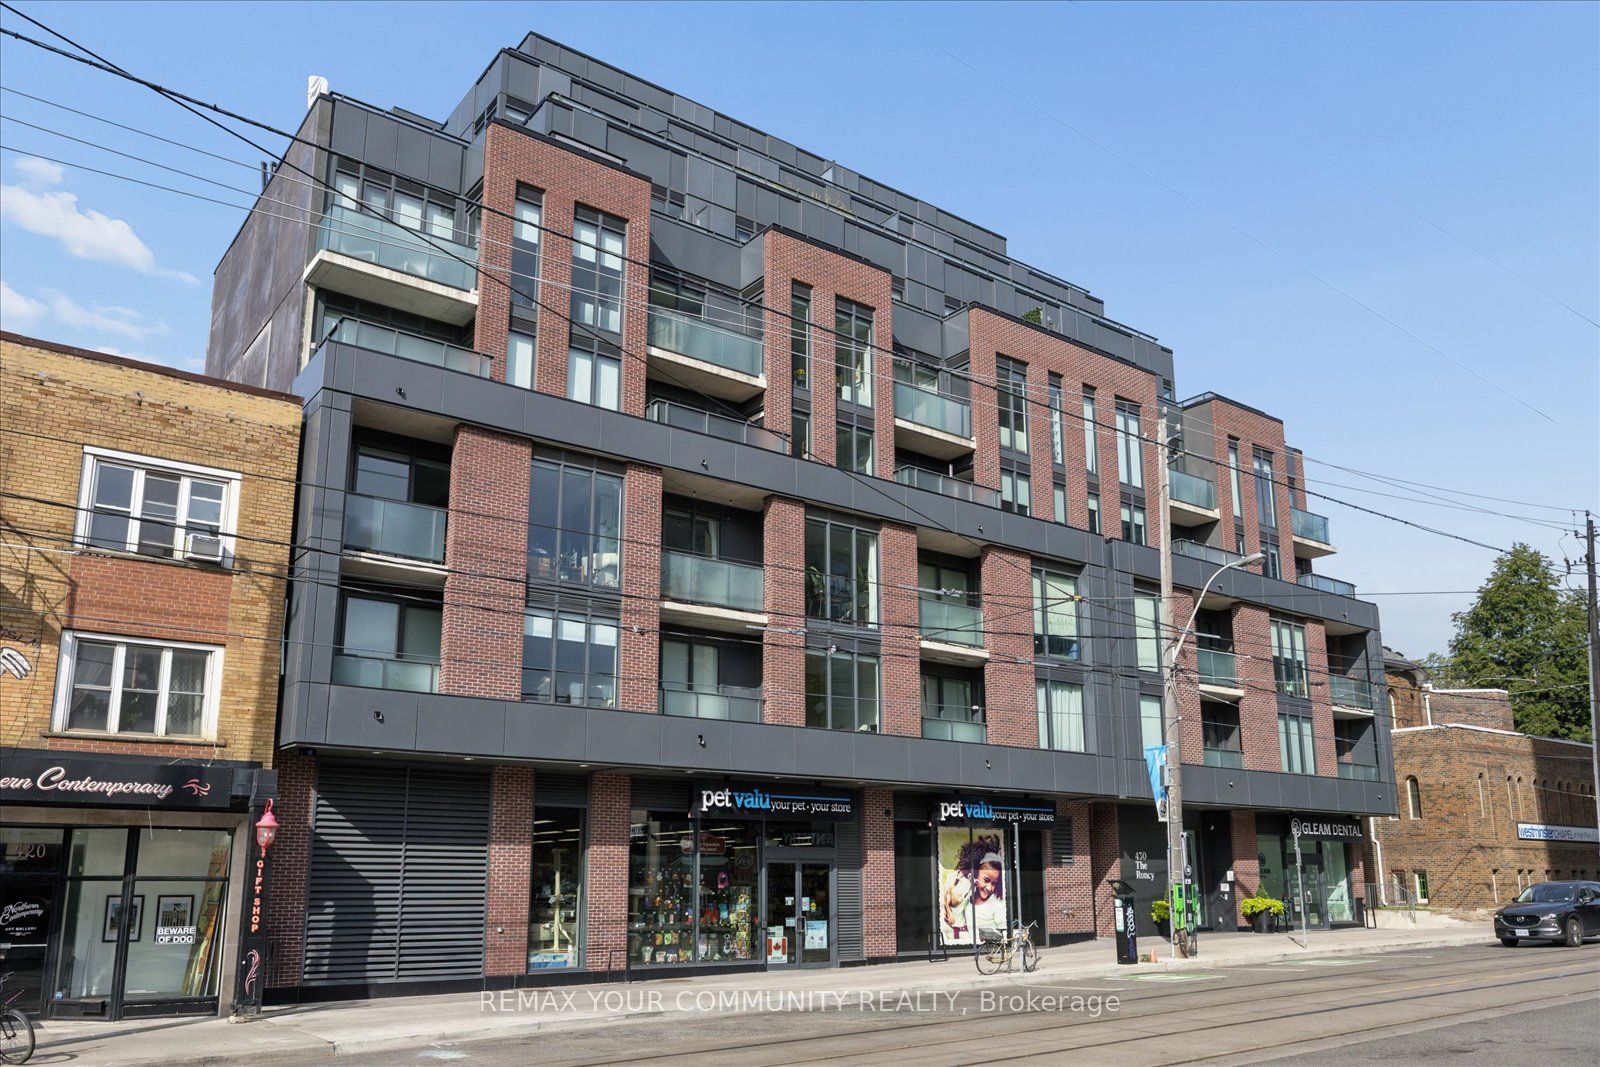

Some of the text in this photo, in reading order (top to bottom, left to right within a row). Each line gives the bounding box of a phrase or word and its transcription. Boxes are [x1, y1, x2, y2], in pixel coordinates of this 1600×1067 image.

[37, 766, 174, 799] Contemporary
[701, 788, 851, 813] pet valu your pet your store
[940, 800, 1054, 822] pet valu your pet your store
[1302, 822, 1362, 837] GLEAM DENTAL
[1520, 826, 1553, 838] westminster
[16, 843, 46, 859] 420
[1135, 861, 1148, 870] The
[1136, 870, 1154, 881] Roncy
[251, 860, 264, 933] GIFT SHOP
[157, 927, 195, 935] BEWARE
[172, 935, 193, 943] DOG
